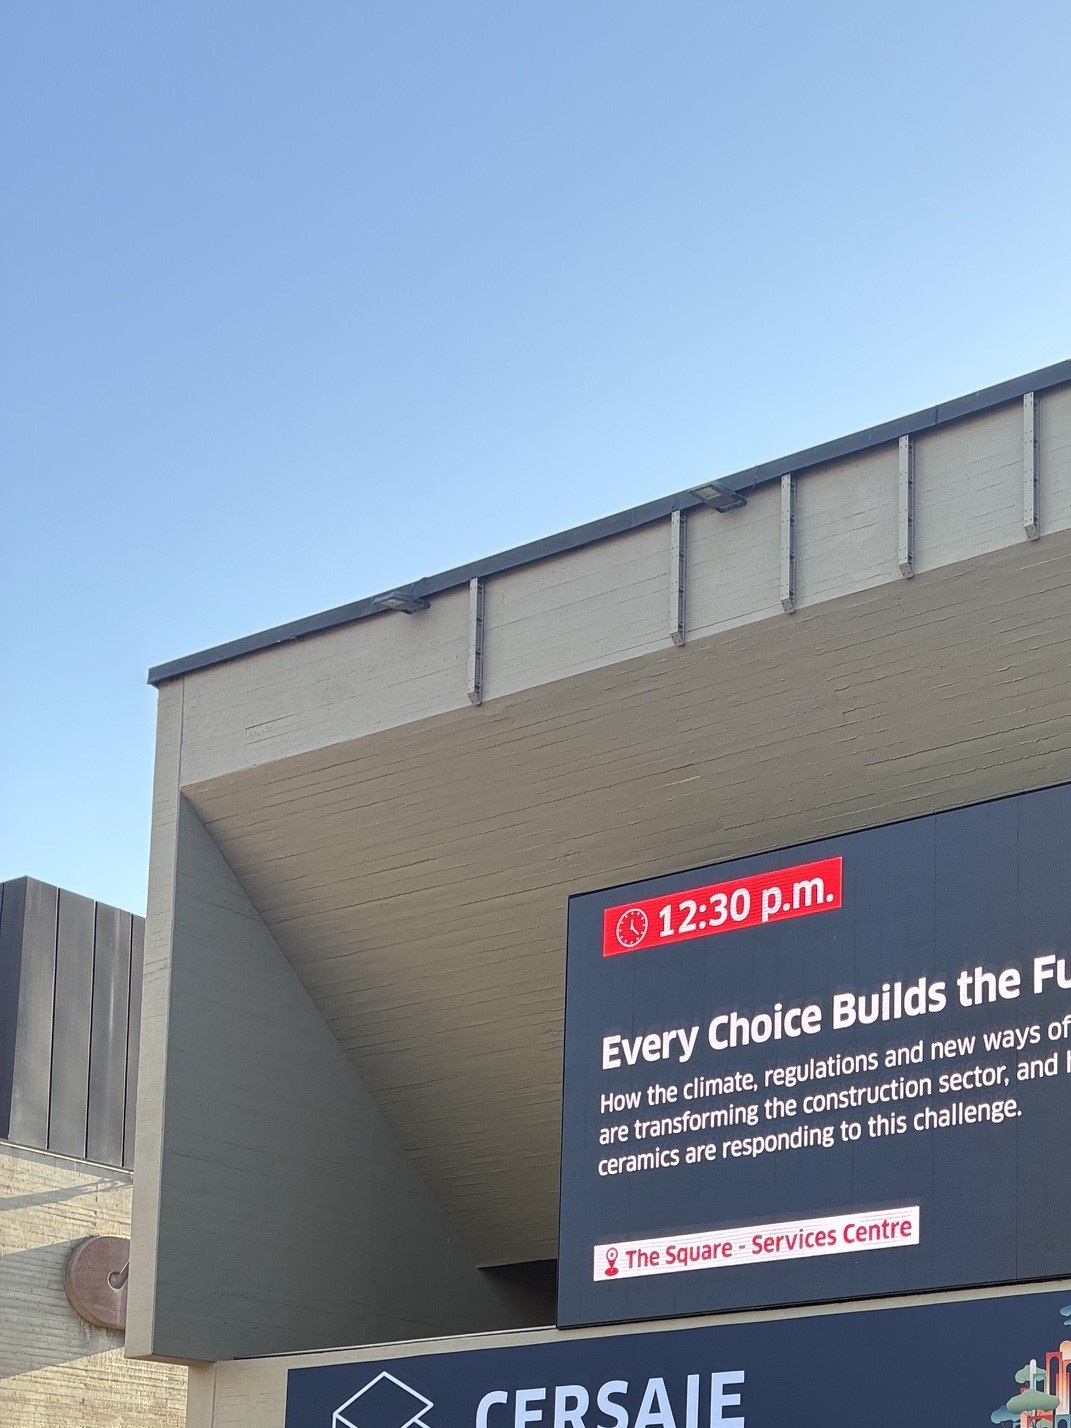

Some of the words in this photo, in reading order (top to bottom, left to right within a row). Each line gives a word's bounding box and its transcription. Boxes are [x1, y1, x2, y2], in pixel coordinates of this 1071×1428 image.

[659, 888, 751, 937] 12:30
[761, 877, 834, 923] p.m.
[602, 1025, 700, 1070] Every
[708, 1002, 822, 1050] Choice
[832, 976, 947, 1030] Builds
[956, 966, 1021, 1007] the
[599, 1124, 629, 1145] are
[633, 1103, 759, 1140] transforming
[763, 1096, 798, 1120] the
[802, 1076, 932, 1114] construction
[938, 1065, 1010, 1094] sector,
[1016, 1052, 1058, 1081] and
[600, 1091, 642, 1114] How
[646, 1083, 678, 1106] the
[683, 1071, 758, 1100] climate,
[764, 1052, 879, 1088] regulations
[884, 1039, 924, 1068] and
[931, 1035, 976, 1061] new
[982, 1025, 1041, 1052] ways
[598, 1146, 680, 1177] ceramics
[685, 1143, 717, 1164] are
[722, 1124, 835, 1159] responding
[839, 1120, 862, 1142] to
[867, 1111, 908, 1138] this
[913, 1098, 1022, 1131] challenge.
[625, 1249, 660, 1269] The
[664, 1241, 734, 1267] Square
[751, 1230, 837, 1256] Services
[842, 1220, 913, 1245] Centre
